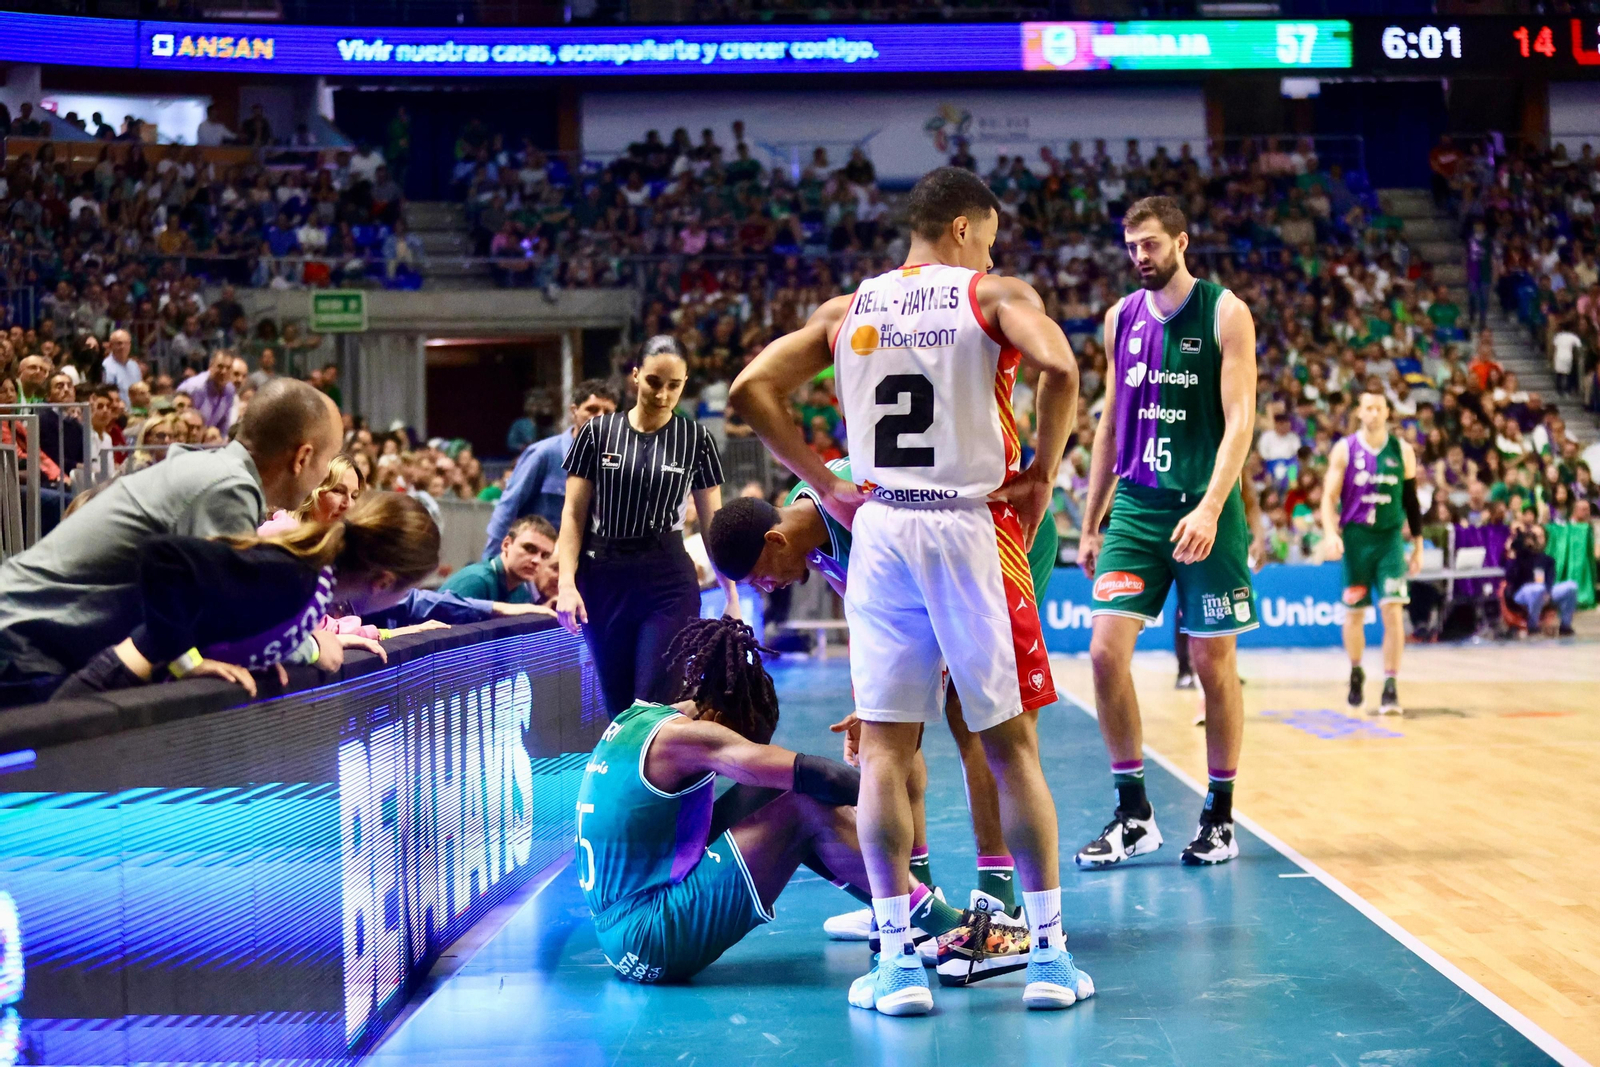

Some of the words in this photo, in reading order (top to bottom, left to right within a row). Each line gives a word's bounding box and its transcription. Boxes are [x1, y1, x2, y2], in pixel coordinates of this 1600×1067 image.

[176, 35, 275, 59] ANSAN
[337, 39, 393, 61] Vivir
[396, 41, 489, 62] nuestras
[491, 44, 556, 65] casas,
[701, 42, 718, 64] y
[719, 42, 788, 60] crecer
[1276, 24, 1318, 63] 57
[1382, 26, 1462, 59] 6:01
[1513, 26, 1556, 57] 14
[880, 323, 894, 332] air
[1148, 369, 1199, 388] Unicaja
[874, 374, 935, 468] 2
[1142, 437, 1172, 473] 45
[873, 486, 958, 502] GOBIERNO
[1261, 596, 1377, 627] Unica
